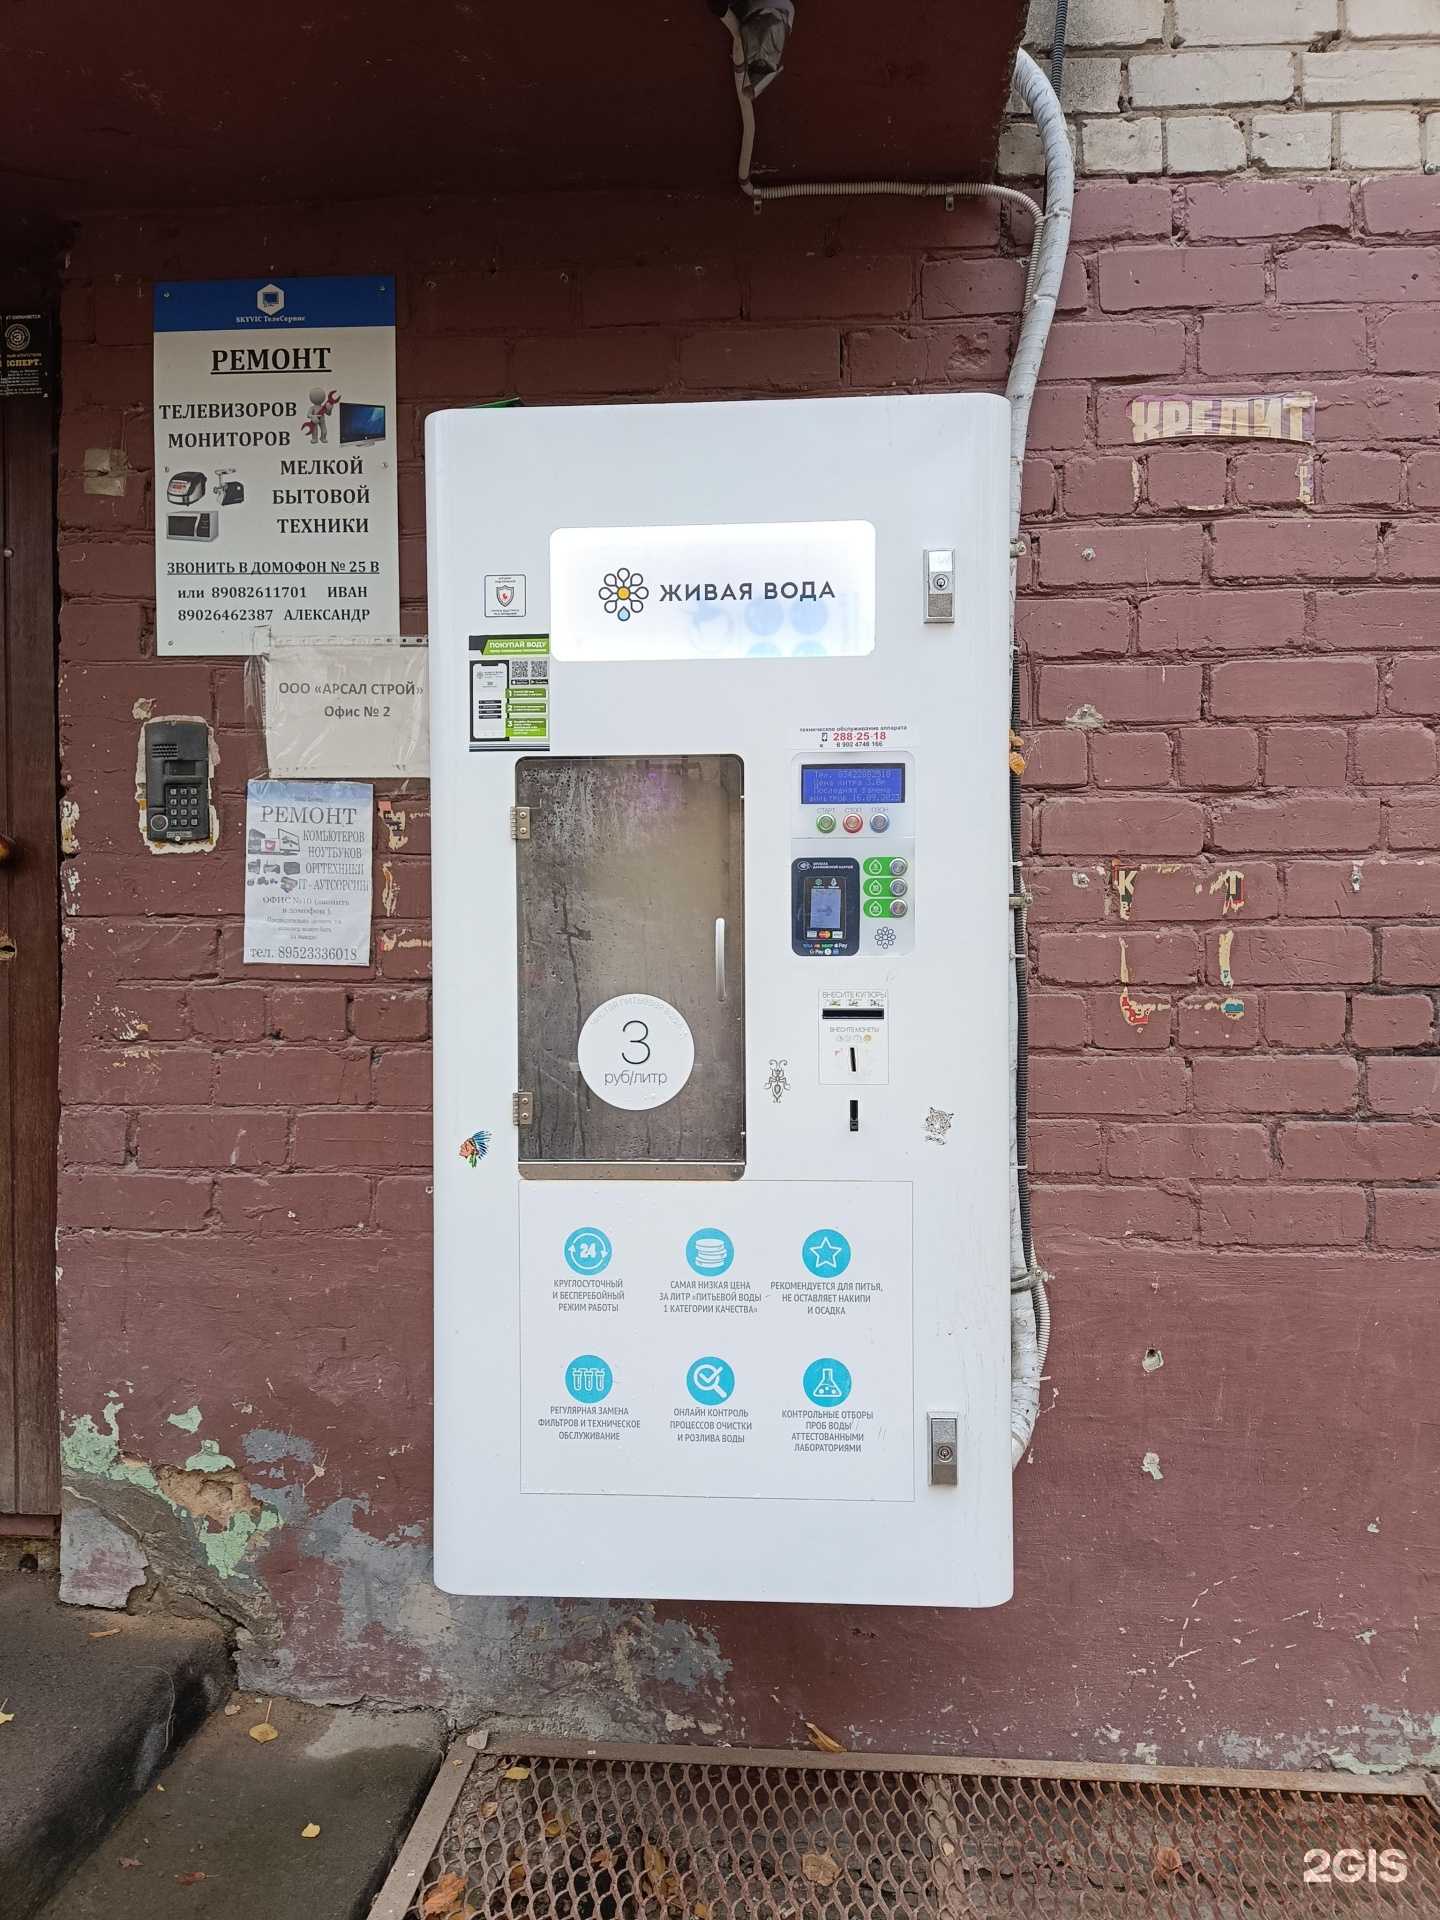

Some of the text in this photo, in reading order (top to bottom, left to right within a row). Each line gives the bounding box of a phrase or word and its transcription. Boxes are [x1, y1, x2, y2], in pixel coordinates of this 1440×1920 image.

[212, 348, 331, 371] РЕМОНТ
[159, 402, 297, 419] ТЕЛЕВИЗОРОВ
[168, 431, 290, 448] МОНИТОРОВ
[280, 456, 363, 475] МЕЛКОЙ
[272, 485, 370, 504] БЫТОВОЙ
[277, 518, 368, 533] ТЕХНИКИ
[167, 561, 379, 575] ЗВОНИТЬ В ДОМОФОН № 25 В
[178, 586, 367, 598] или 89082611701 ИВАН
[659, 580, 836, 602] ЖИВАЯ ВОДА
[178, 609, 370, 622] 89026462387 АЛЕКСАНДР
[489, 640, 525, 648] ПОКУПАЙ
[279, 681, 424, 695] ООО «АРСАЛ СТРОЙ»
[324, 706, 390, 719] Офис № 2
[833, 732, 886, 741] 288-25-18
[260, 806, 357, 824] РЕМОНТ
[308, 847, 362, 858] НОУТБУКОВ
[306, 863, 364, 875] ОРГТЕХНИКИ
[262, 896, 291, 904] ОФИС
[250, 946, 358, 960] тел. 89523336018
[621, 1020, 650, 1065] 3
[604, 1069, 668, 1086] руб/литр
[580, 1243, 596, 1258] 24
[553, 1279, 623, 1288] КРУГЛОСУТОЧНЫЙ
[670, 1280, 751, 1290] САМАЯ НИЗКАЯ ЦЕНА
[770, 1281, 883, 1292] РЕКОМЕНДУЕТСЯ ДЛЯ ПИТЬЯ,
[552, 1290, 625, 1300] И БЕСПЕРЕБОЙНЫЙ
[659, 1292, 669, 1301] ЗА
[670, 1292, 690, 1301] ЛИТР
[738, 1293, 761, 1302] ВОДЫ
[782, 1294, 871, 1303] НЕ ОСТАВЛЯЕТ НАКИПИ
[558, 1303, 619, 1312] РЕЖИМ РАБОТЫ
[670, 1304, 714, 1313] КАТЕГОРИИ
[807, 1306, 846, 1315] И ОСАДКА
[550, 1406, 629, 1415] РЕГУЛЯРНАЯ ЗАМЕНА
[673, 1407, 749, 1417] ОНЛАЙН КОНТРОЛЬ
[781, 1410, 874, 1419] КОНТРОЛЬНЫЕ ОТБОРЫ
[538, 1418, 641, 1428] ФИЛЬТРОВ И ТЕХНИЧЕСКОЕ
[670, 1420, 752, 1430] ПРОЦЕССОВ ОЧИСТКИ
[805, 1421, 852, 1430] ПРОБ ВОДЫ
[558, 1431, 621, 1440] ОБСЛУЖИВАНИЕ
[677, 1433, 745, 1443] И РОЗЛИВА ВОДЫ
[791, 1432, 864, 1441] АТТЕСТОВАННЫМИ
[794, 1443, 862, 1452] ЛАБОРАТОРИЯМИ
